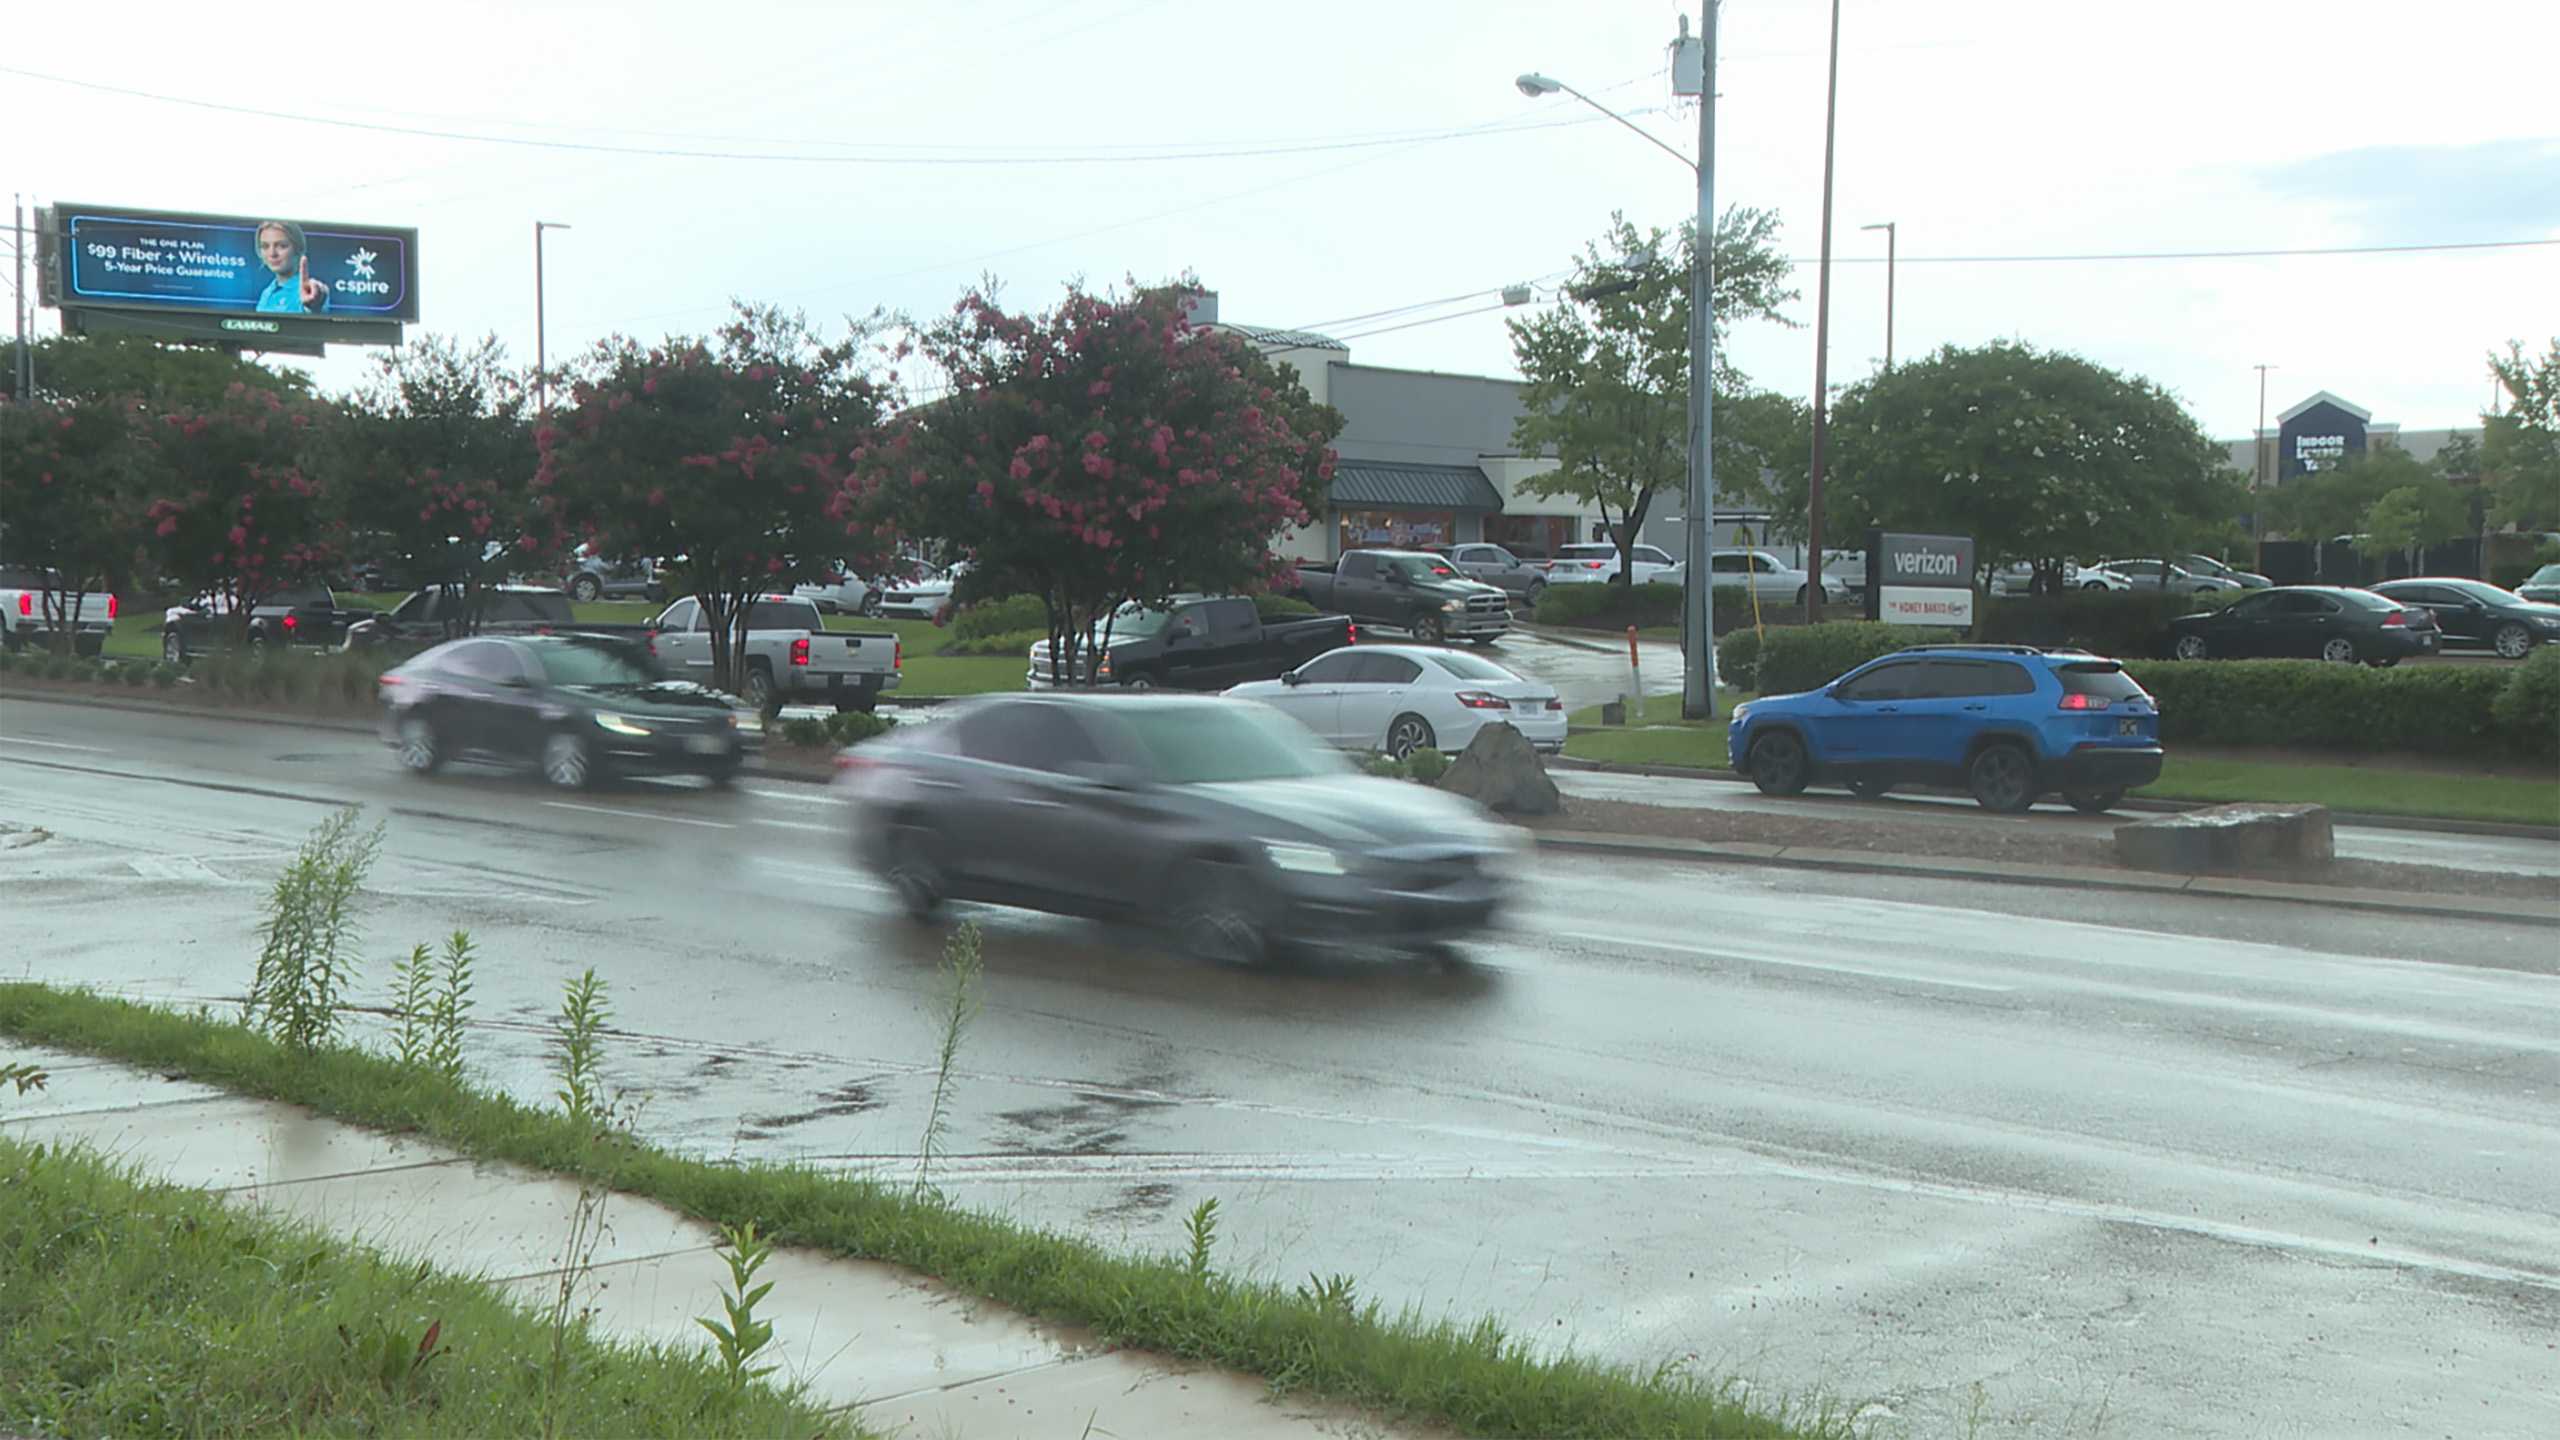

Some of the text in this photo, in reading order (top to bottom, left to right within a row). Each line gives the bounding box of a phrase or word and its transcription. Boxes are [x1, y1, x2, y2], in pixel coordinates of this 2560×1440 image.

[140, 238, 205, 250] THE ONE PLAN
[88, 243, 246, 267] $99 Fiber + Wireless
[104, 260, 234, 279] 5-Year Price Guarantee
[335, 279, 389, 294] cspire
[226, 320, 274, 332] LAMAR
[1894, 547, 1957, 575] verizon
